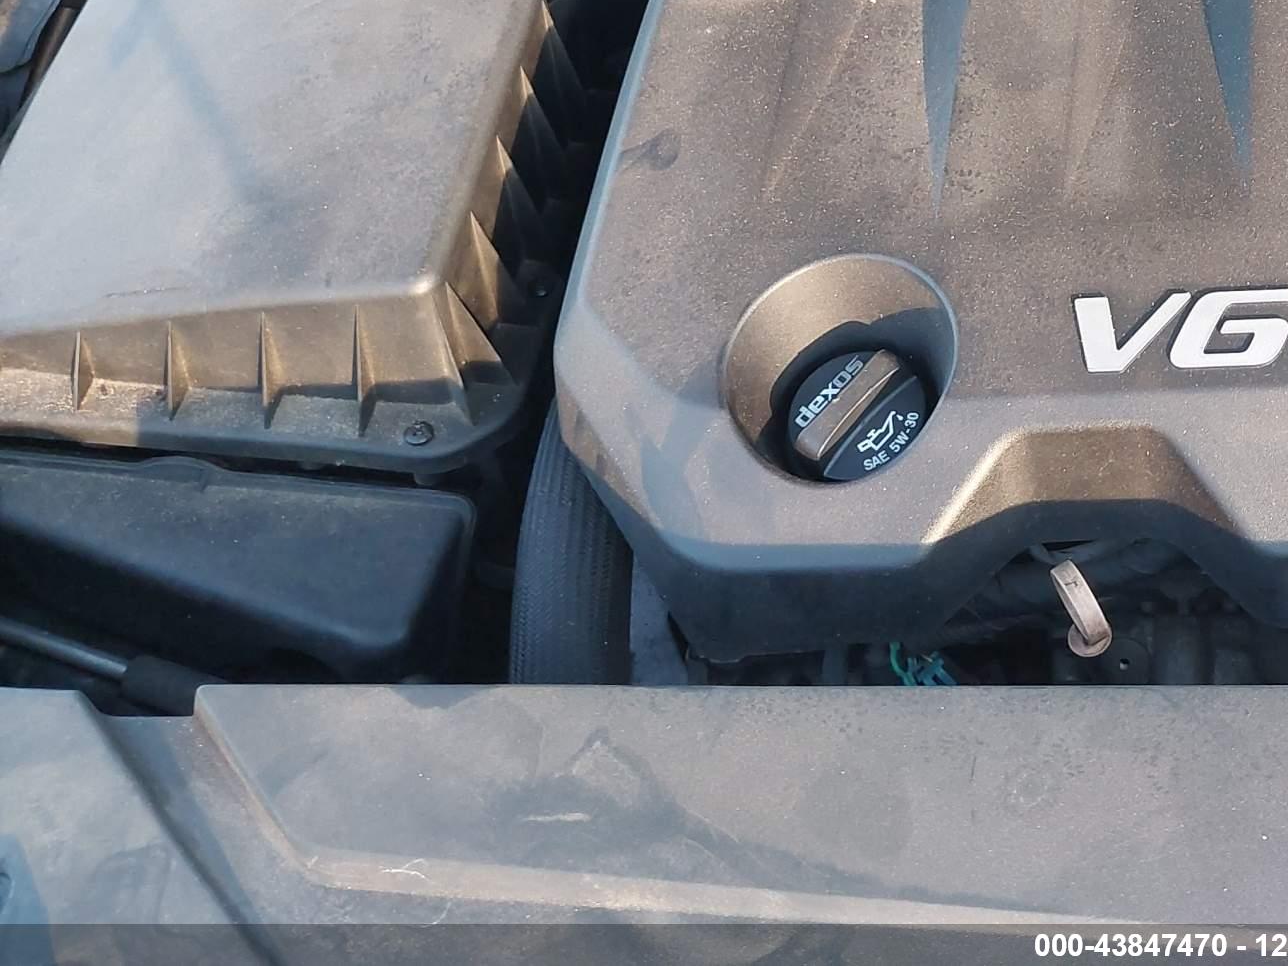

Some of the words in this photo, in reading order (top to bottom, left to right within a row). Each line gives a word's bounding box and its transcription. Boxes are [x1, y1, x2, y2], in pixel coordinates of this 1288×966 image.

[795, 355, 863, 428] dexos
[863, 450, 890, 471] SAE
[889, 412, 919, 453] 5W-30
